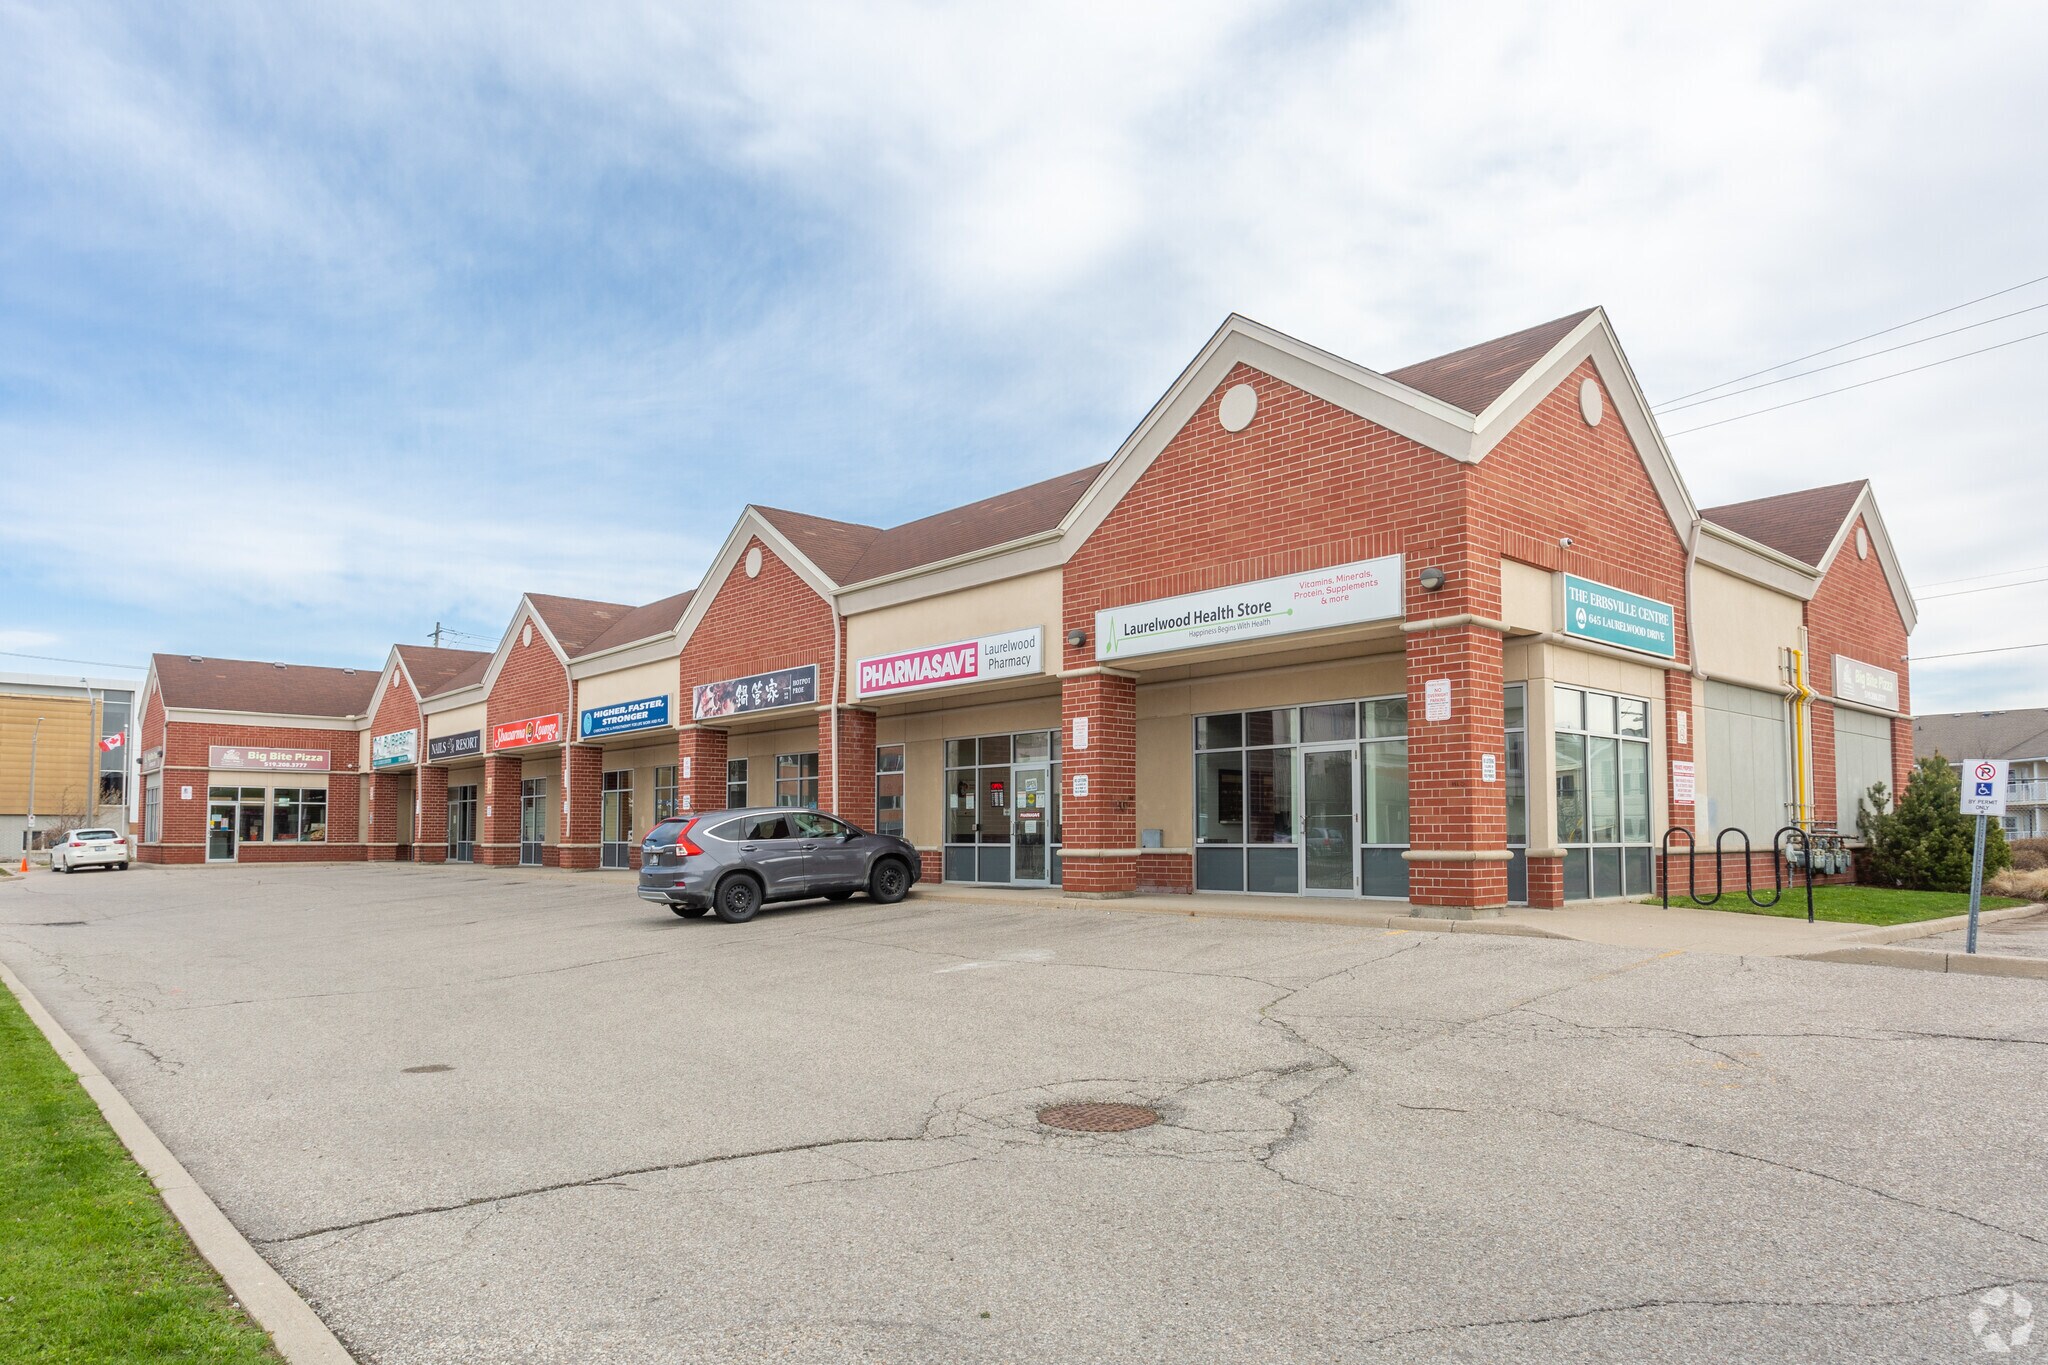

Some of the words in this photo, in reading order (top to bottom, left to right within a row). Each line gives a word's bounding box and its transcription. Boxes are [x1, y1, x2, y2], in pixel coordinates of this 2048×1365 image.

[1299, 578, 1334, 589] Vitamins,
[1336, 570, 1373, 582] Minerals,
[1294, 588, 1324, 600] Protein,
[1326, 579, 1378, 594] Supplements
[1329, 594, 1349, 603] more
[1568, 586, 1588, 604] THE
[1590, 592, 1637, 617] ERBSVILLE
[1638, 606, 1669, 626] CENTRE
[1124, 611, 1190, 636] Laurelwood
[1193, 604, 1234, 624] Health
[1237, 601, 1272, 617] Store
[1188, 628, 1217, 638] Happiness
[1217, 625, 1236, 634] Begins
[1236, 621, 1250, 629] With
[1251, 618, 1271, 628] Health
[1588, 613, 1602, 626] 645
[1602, 616, 1646, 637] LAURELWOOD
[1647, 628, 1665, 642] DRIVE
[984, 635, 1035, 656] Laurelwood
[862, 647, 975, 689] PHARMASAVE
[988, 654, 1031, 670] Pharmacy
[593, 706, 627, 718] HIGHER,
[628, 699, 664, 712] FASTER,
[602, 711, 648, 726] STRONGER
[494, 729, 526, 748] Shawarma
[534, 720, 556, 740] Lounge
[431, 741, 446, 755] NAILS
[455, 736, 478, 751] RESORT
[247, 751, 267, 762] Big
[269, 752, 292, 760] Bite
[295, 753, 323, 761] Pizza
